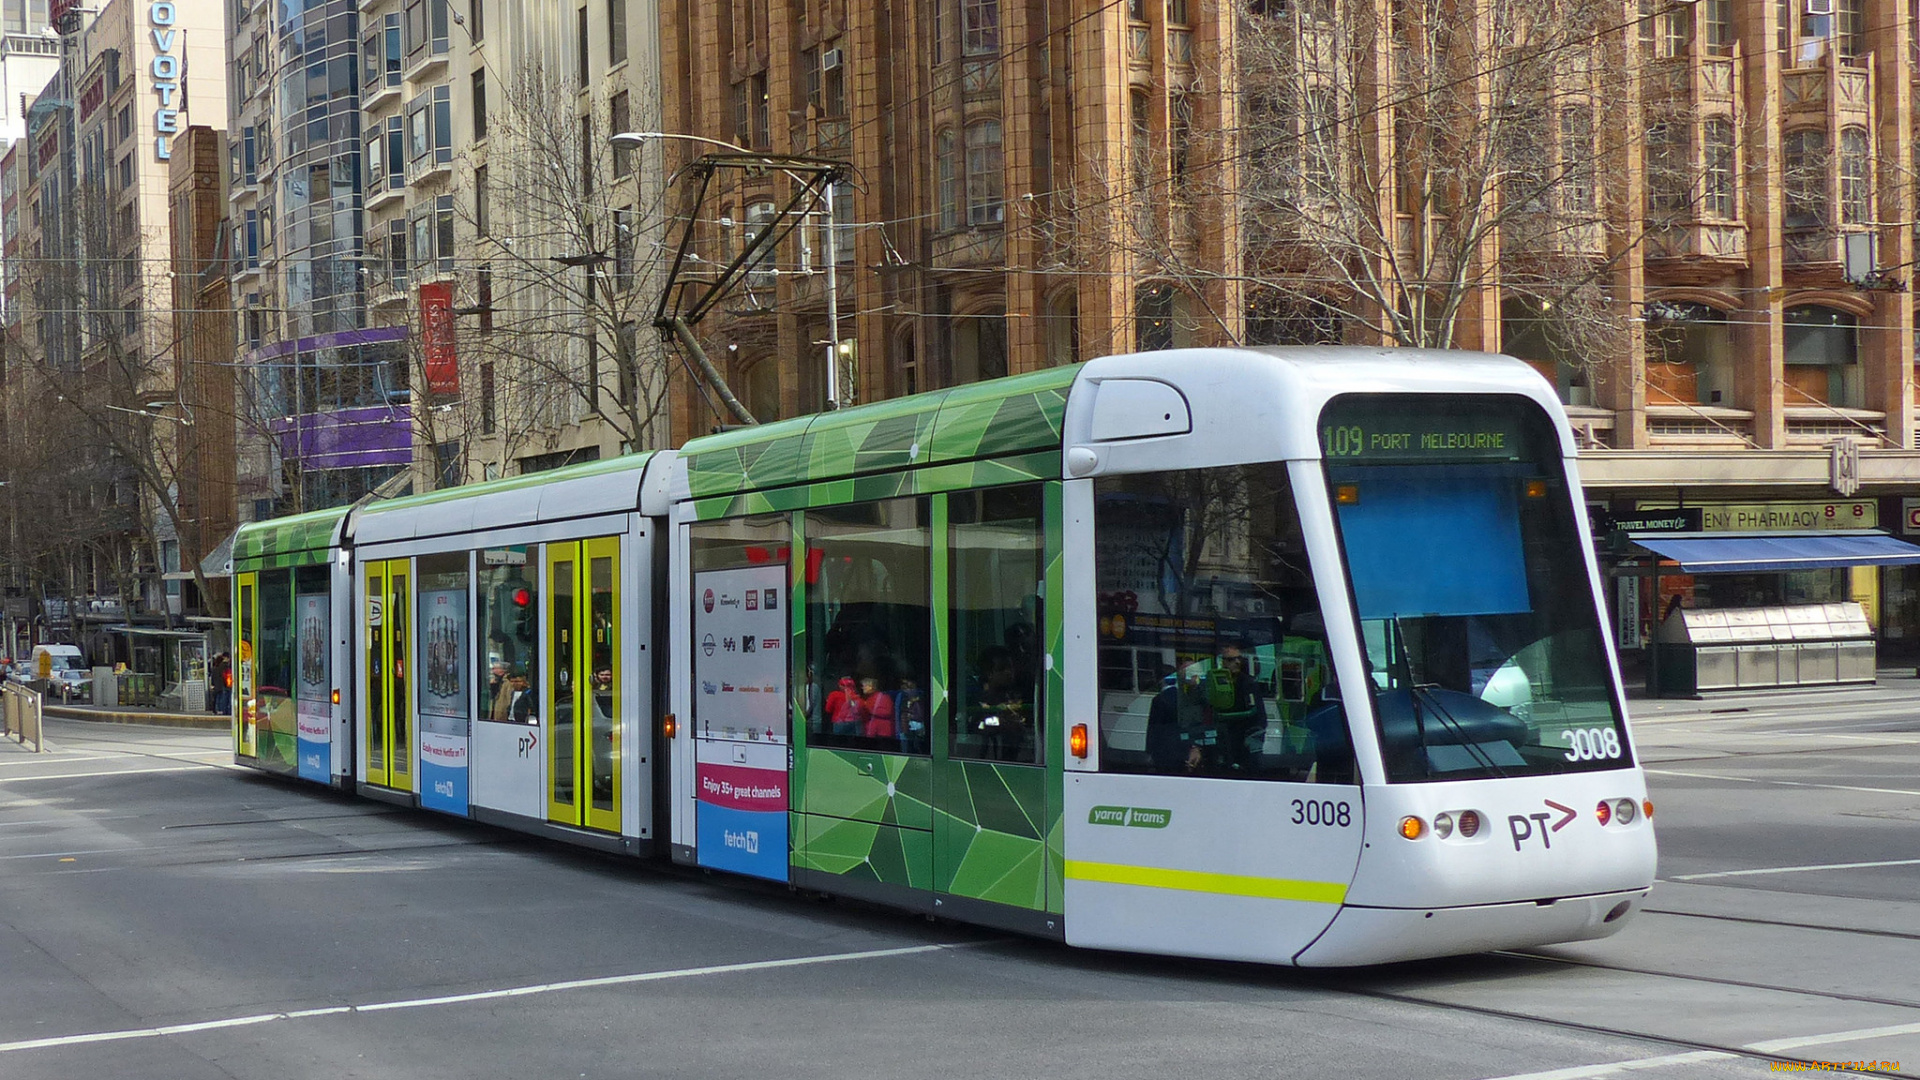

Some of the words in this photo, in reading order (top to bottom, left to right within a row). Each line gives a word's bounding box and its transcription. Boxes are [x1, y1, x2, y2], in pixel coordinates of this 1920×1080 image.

[151, 0, 177, 160] OVOTEL
[1324, 426, 1363, 456] 109
[1371, 433, 1411, 449] PORT
[1421, 433, 1504, 448] MELBOURNE
[1616, 520, 1647, 530] TRAVEL
[1646, 519, 1674, 529] MONEY
[1738, 511, 1820, 528] PHARMACY
[1562, 727, 1621, 762] 3008
[703, 777, 720, 795] Enjoy
[721, 782, 733, 795] 35+
[734, 787, 751, 799] great
[751, 785, 781, 798] channels
[1094, 808, 1122, 821] yarra
[1133, 810, 1165, 824] trams
[1291, 799, 1351, 827] 3008
[1508, 812, 1550, 851] PT
